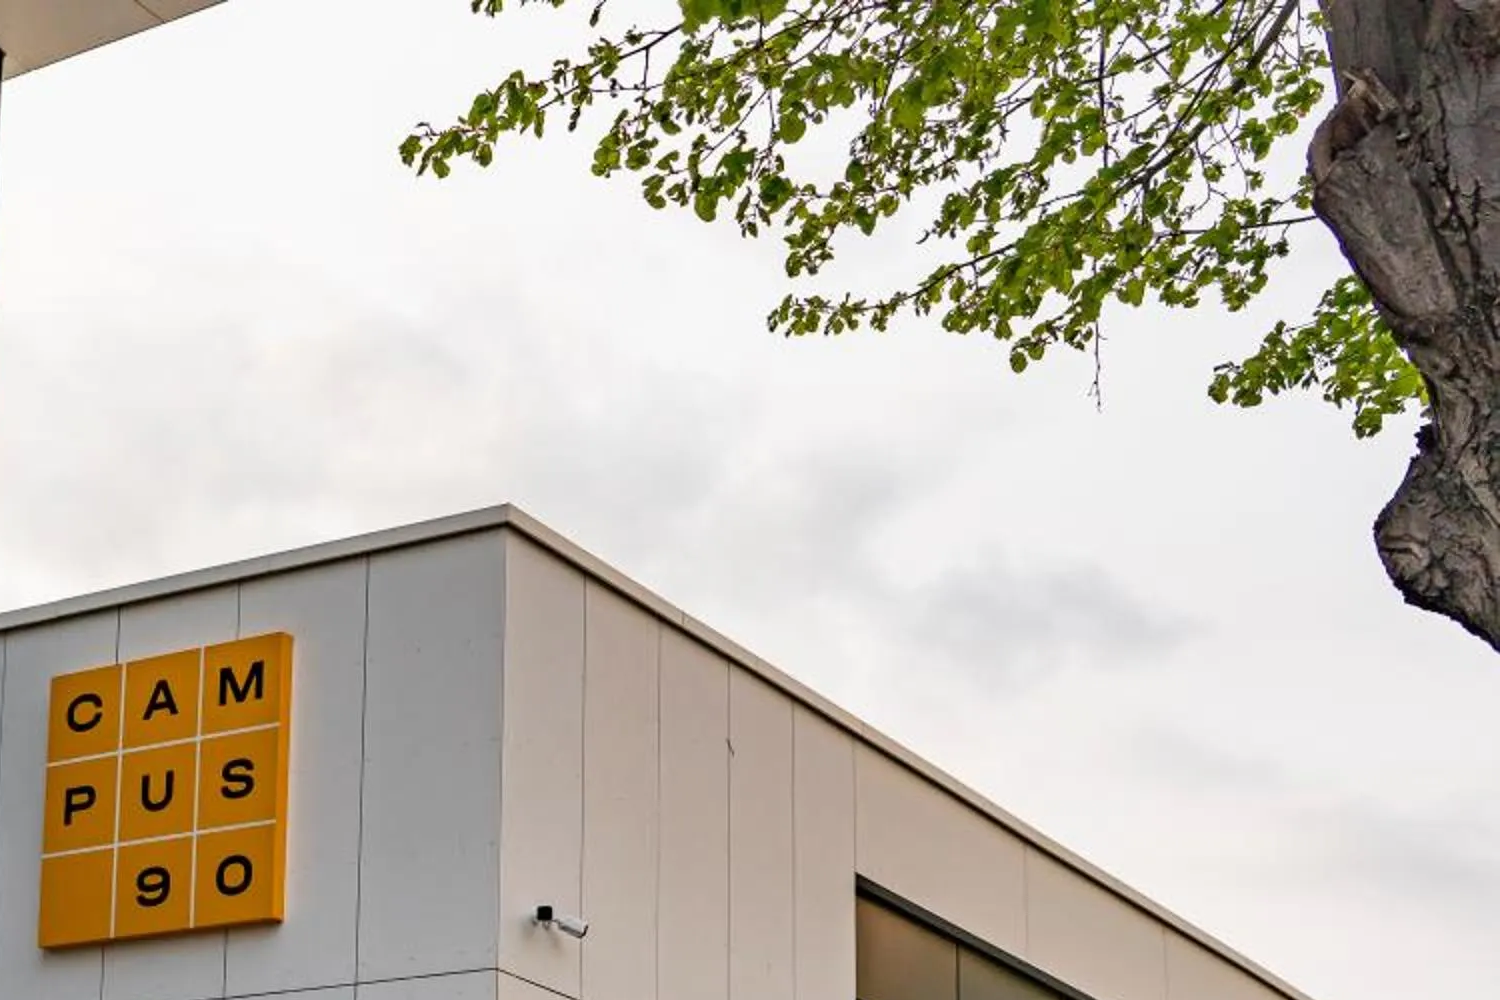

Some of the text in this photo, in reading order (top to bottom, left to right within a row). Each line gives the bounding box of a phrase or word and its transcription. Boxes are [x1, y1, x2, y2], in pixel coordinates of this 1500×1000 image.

[66, 660, 265, 733] CAM
[63, 758, 256, 827] PUS
[135, 854, 254, 908] 90
